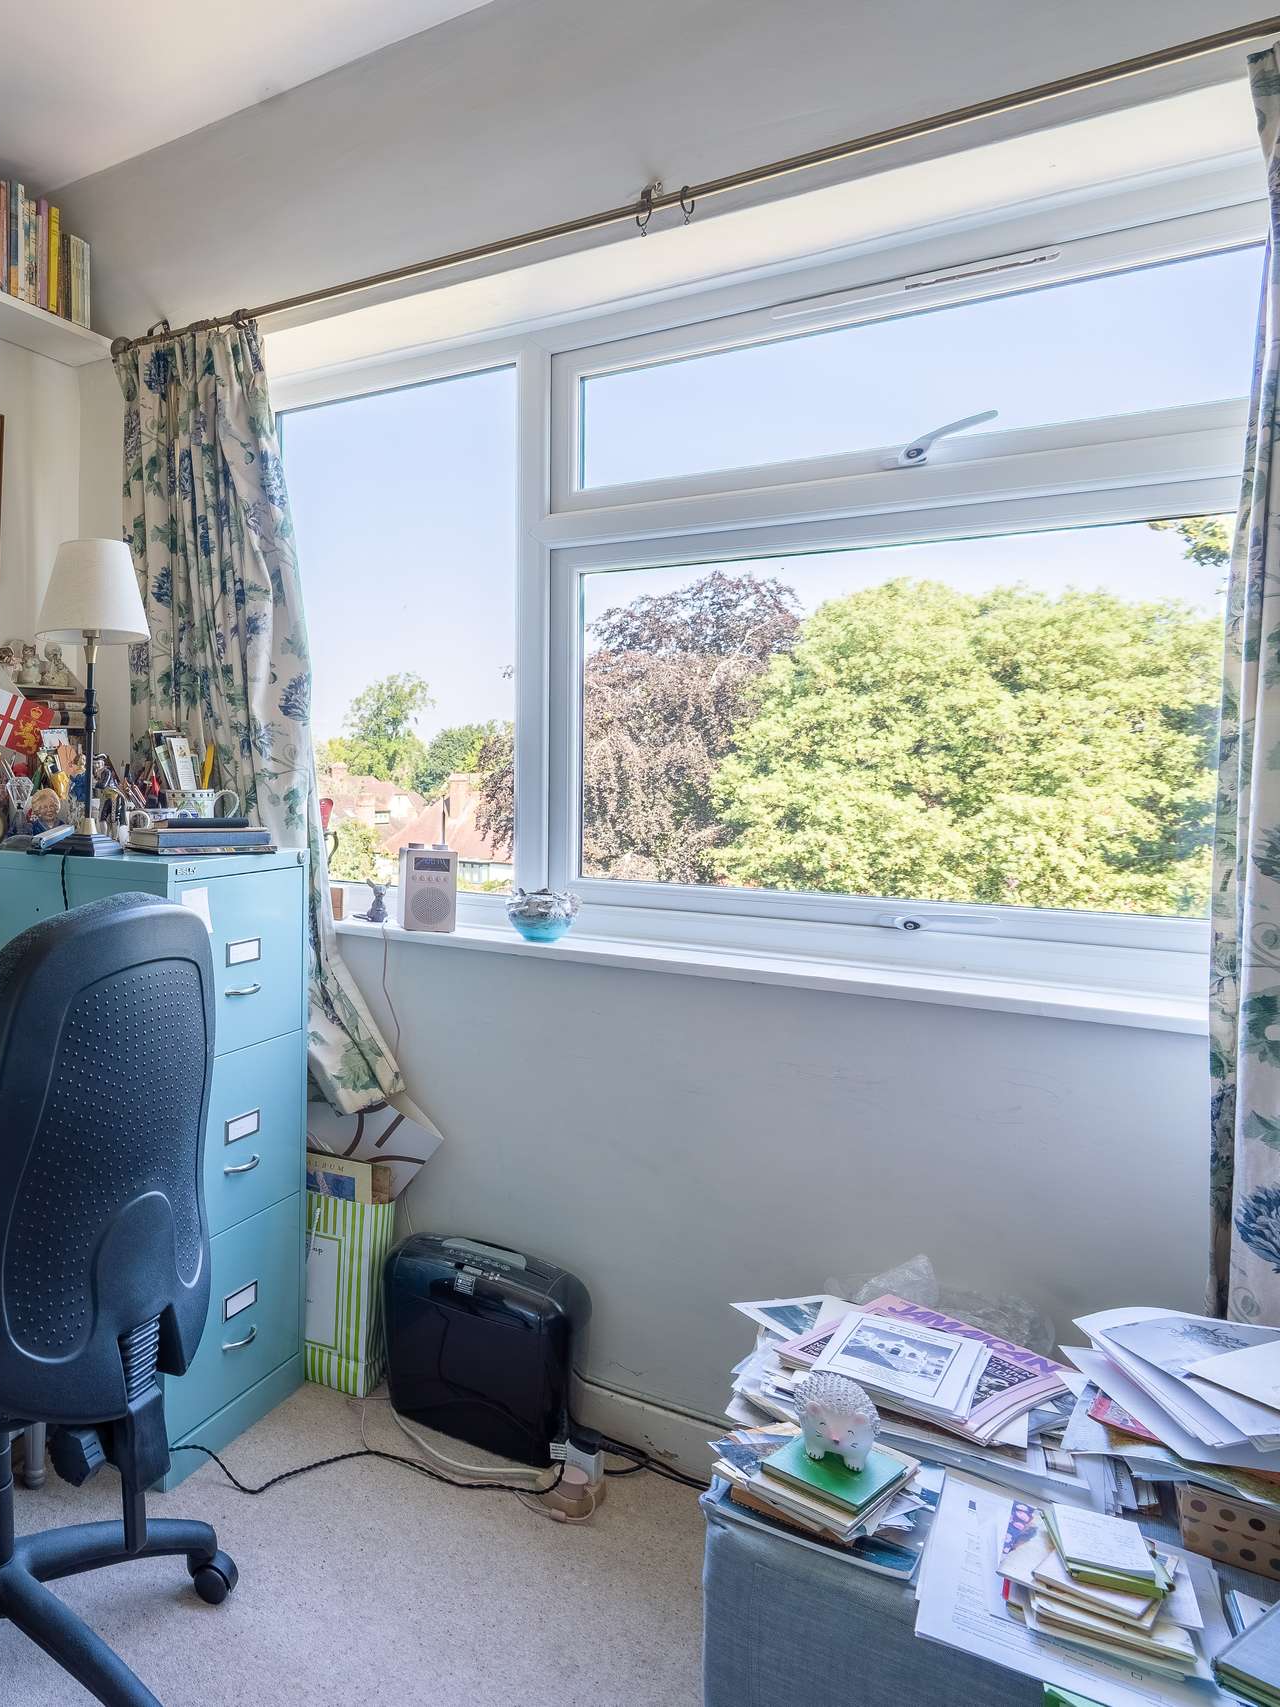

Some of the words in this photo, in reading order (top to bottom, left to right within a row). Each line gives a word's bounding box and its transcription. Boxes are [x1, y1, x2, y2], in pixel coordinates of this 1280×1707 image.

[888, 1304, 1062, 1373] JAMAICAN
[987, 1366, 1019, 1382] EDIA
[991, 1357, 1036, 1378] OMEN
